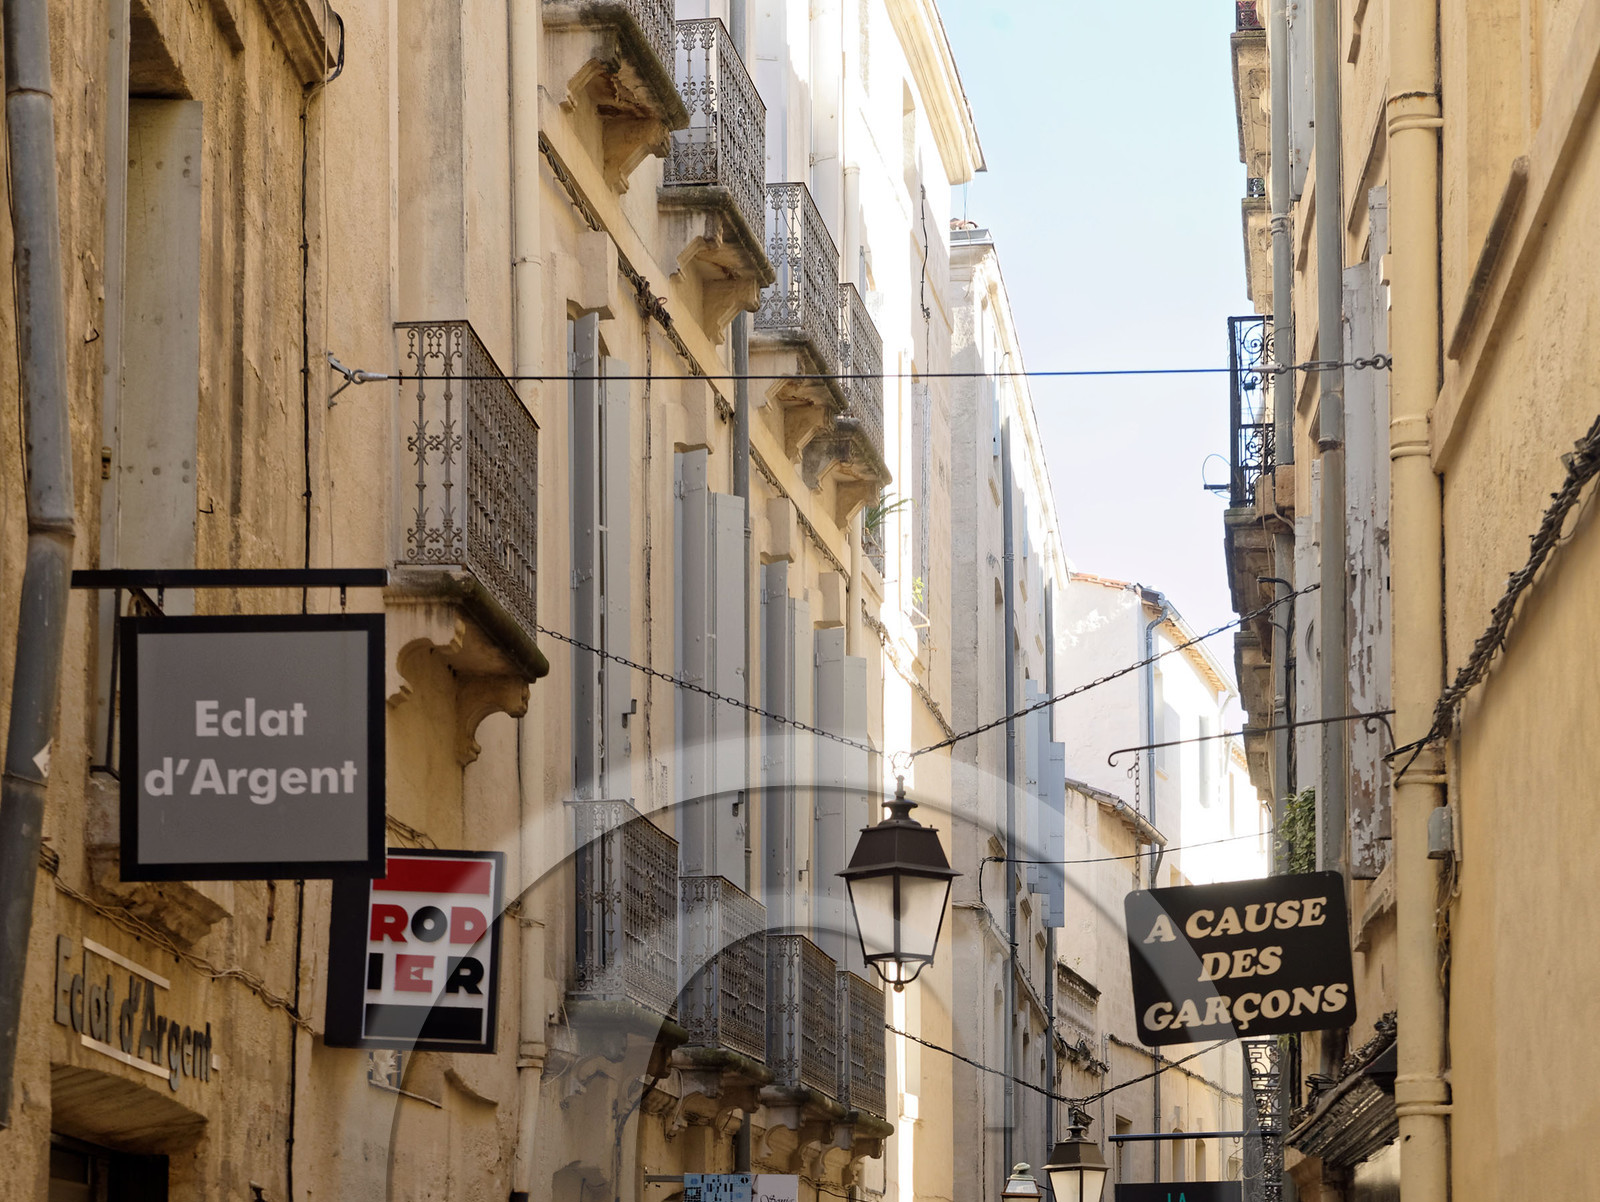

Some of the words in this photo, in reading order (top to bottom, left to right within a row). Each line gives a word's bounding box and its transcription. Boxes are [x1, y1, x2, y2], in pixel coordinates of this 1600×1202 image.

[196, 698, 307, 737] Eclat
[145, 757, 358, 805] d'Argent
[370, 904, 487, 944] ROD
[1144, 914, 1177, 944] A
[1185, 897, 1327, 939] CAUSE
[367, 953, 484, 995] IER
[1197, 946, 1283, 982] DES
[54, 934, 115, 1044] Eclat
[1143, 983, 1349, 1031] GARÇONS
